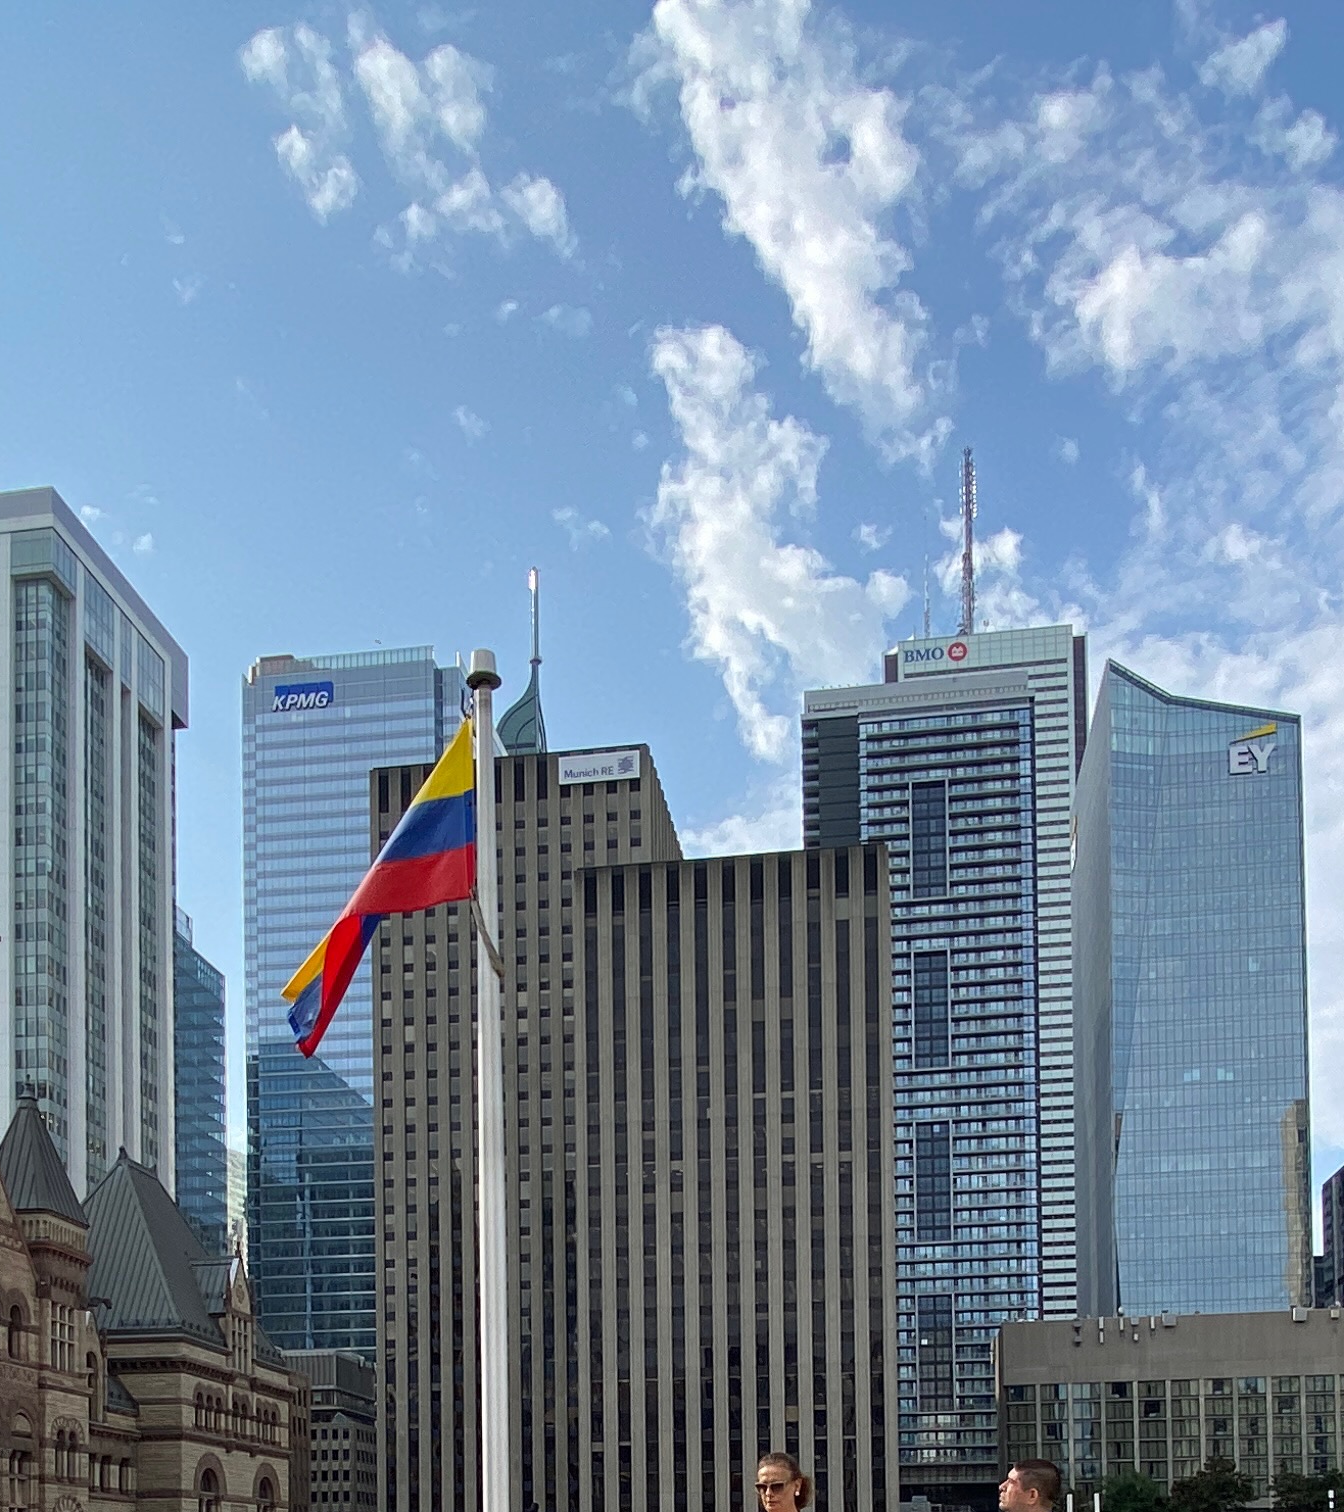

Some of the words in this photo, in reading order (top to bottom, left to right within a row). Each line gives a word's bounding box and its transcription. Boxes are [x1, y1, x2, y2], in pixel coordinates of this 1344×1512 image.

[904, 647, 944, 663] BMO
[272, 691, 329, 711] KPMG
[1229, 743, 1275, 775] EY
[564, 767, 599, 779] Munich
[601, 766, 614, 776] RE
